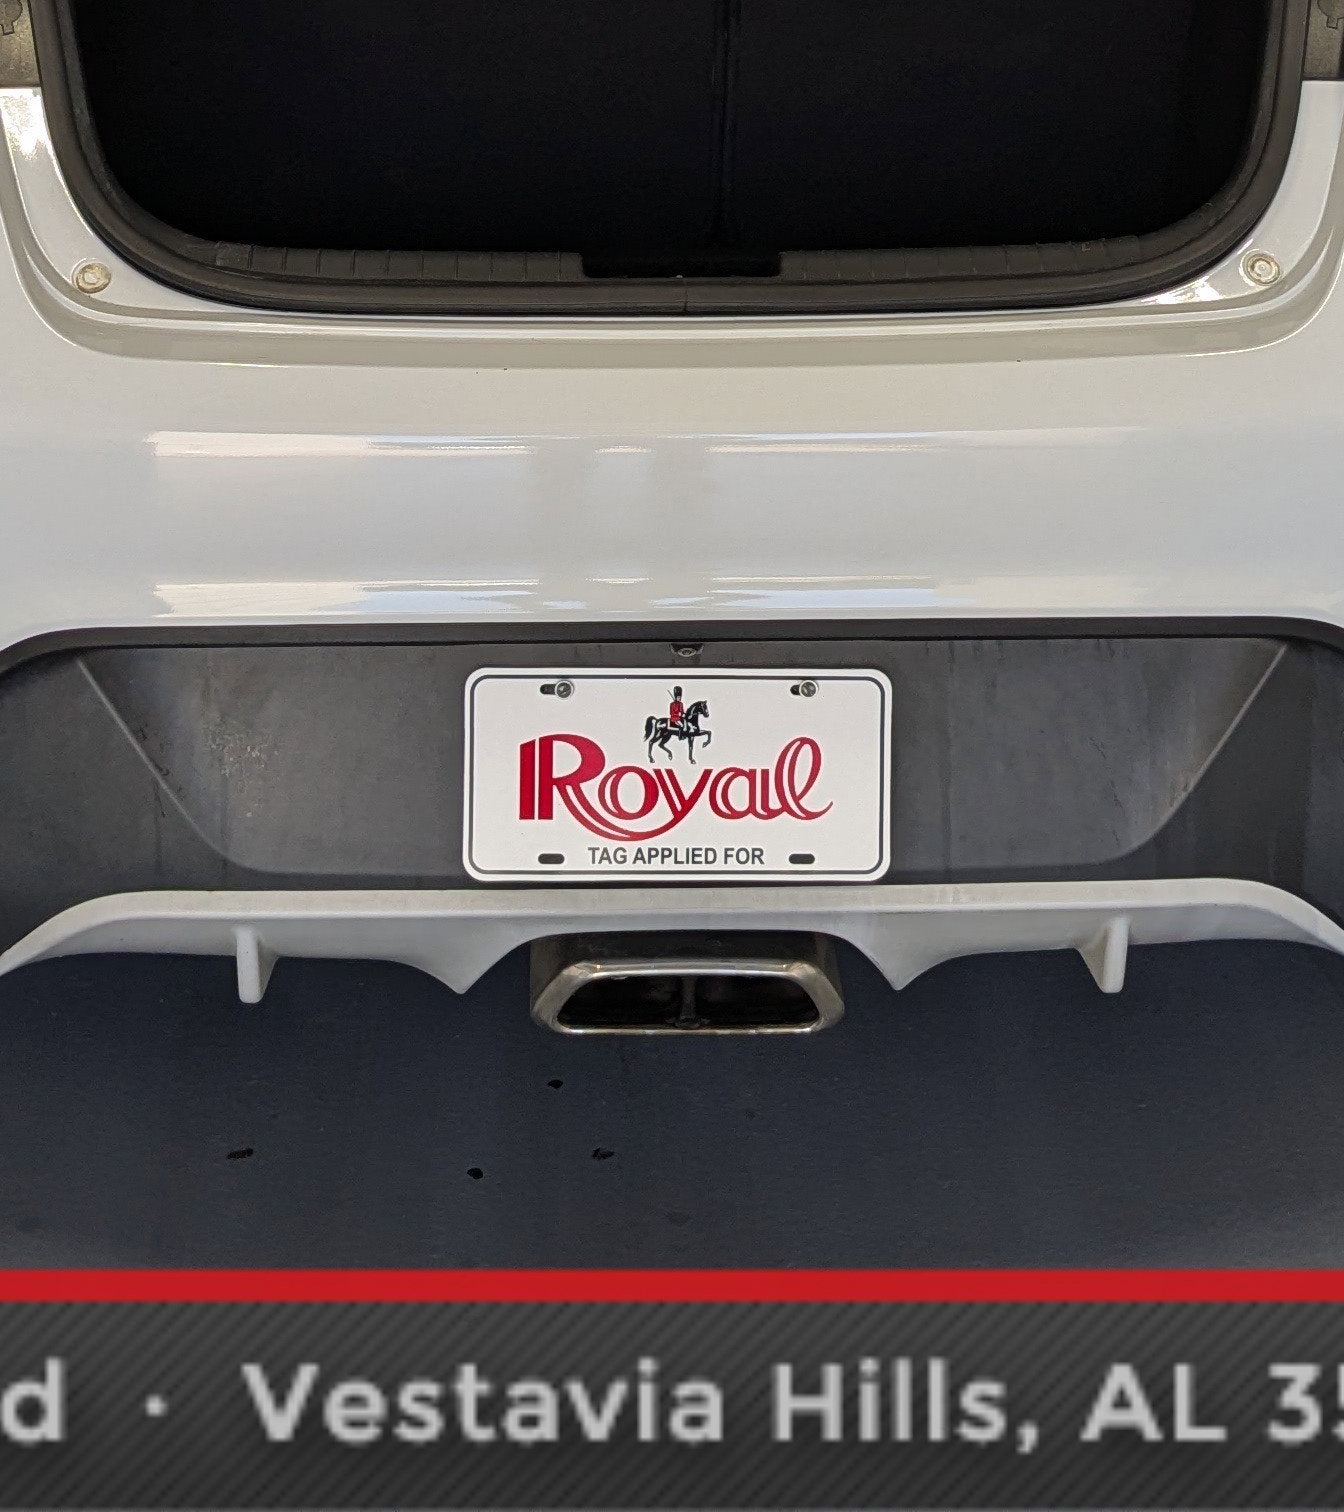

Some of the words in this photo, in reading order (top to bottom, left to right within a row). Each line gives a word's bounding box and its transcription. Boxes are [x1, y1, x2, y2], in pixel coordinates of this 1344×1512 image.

[518, 733, 834, 842] Royal
[587, 846, 628, 865] TAG
[632, 846, 718, 865] APPLIED
[723, 846, 765, 865] FOR
